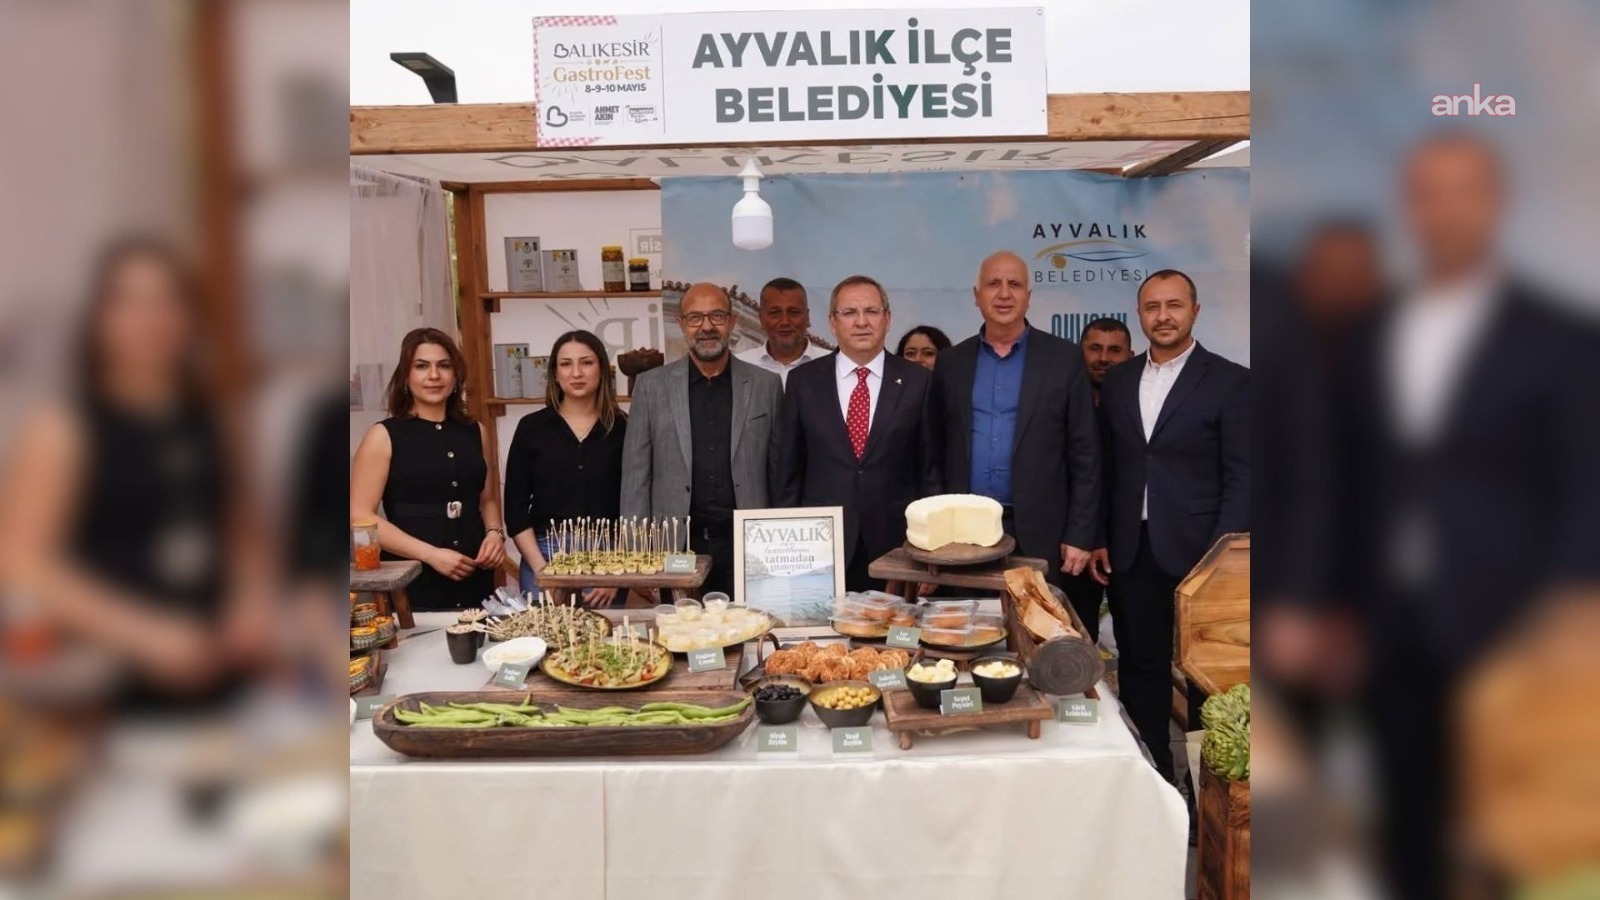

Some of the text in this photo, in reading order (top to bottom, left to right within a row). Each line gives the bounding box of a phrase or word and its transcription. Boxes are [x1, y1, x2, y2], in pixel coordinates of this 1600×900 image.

[554, 40, 650, 58] BALIKESİR
[692, 17, 1013, 76] AYVALIK İLÇE
[553, 66, 651, 82] GastroFest
[585, 83, 647, 93] 8-9-10 MAYIS
[715, 71, 993, 123] BELEDİYESİ
[1032, 222, 1147, 239] AYVALIK
[752, 527, 828, 543] AYVALIK
